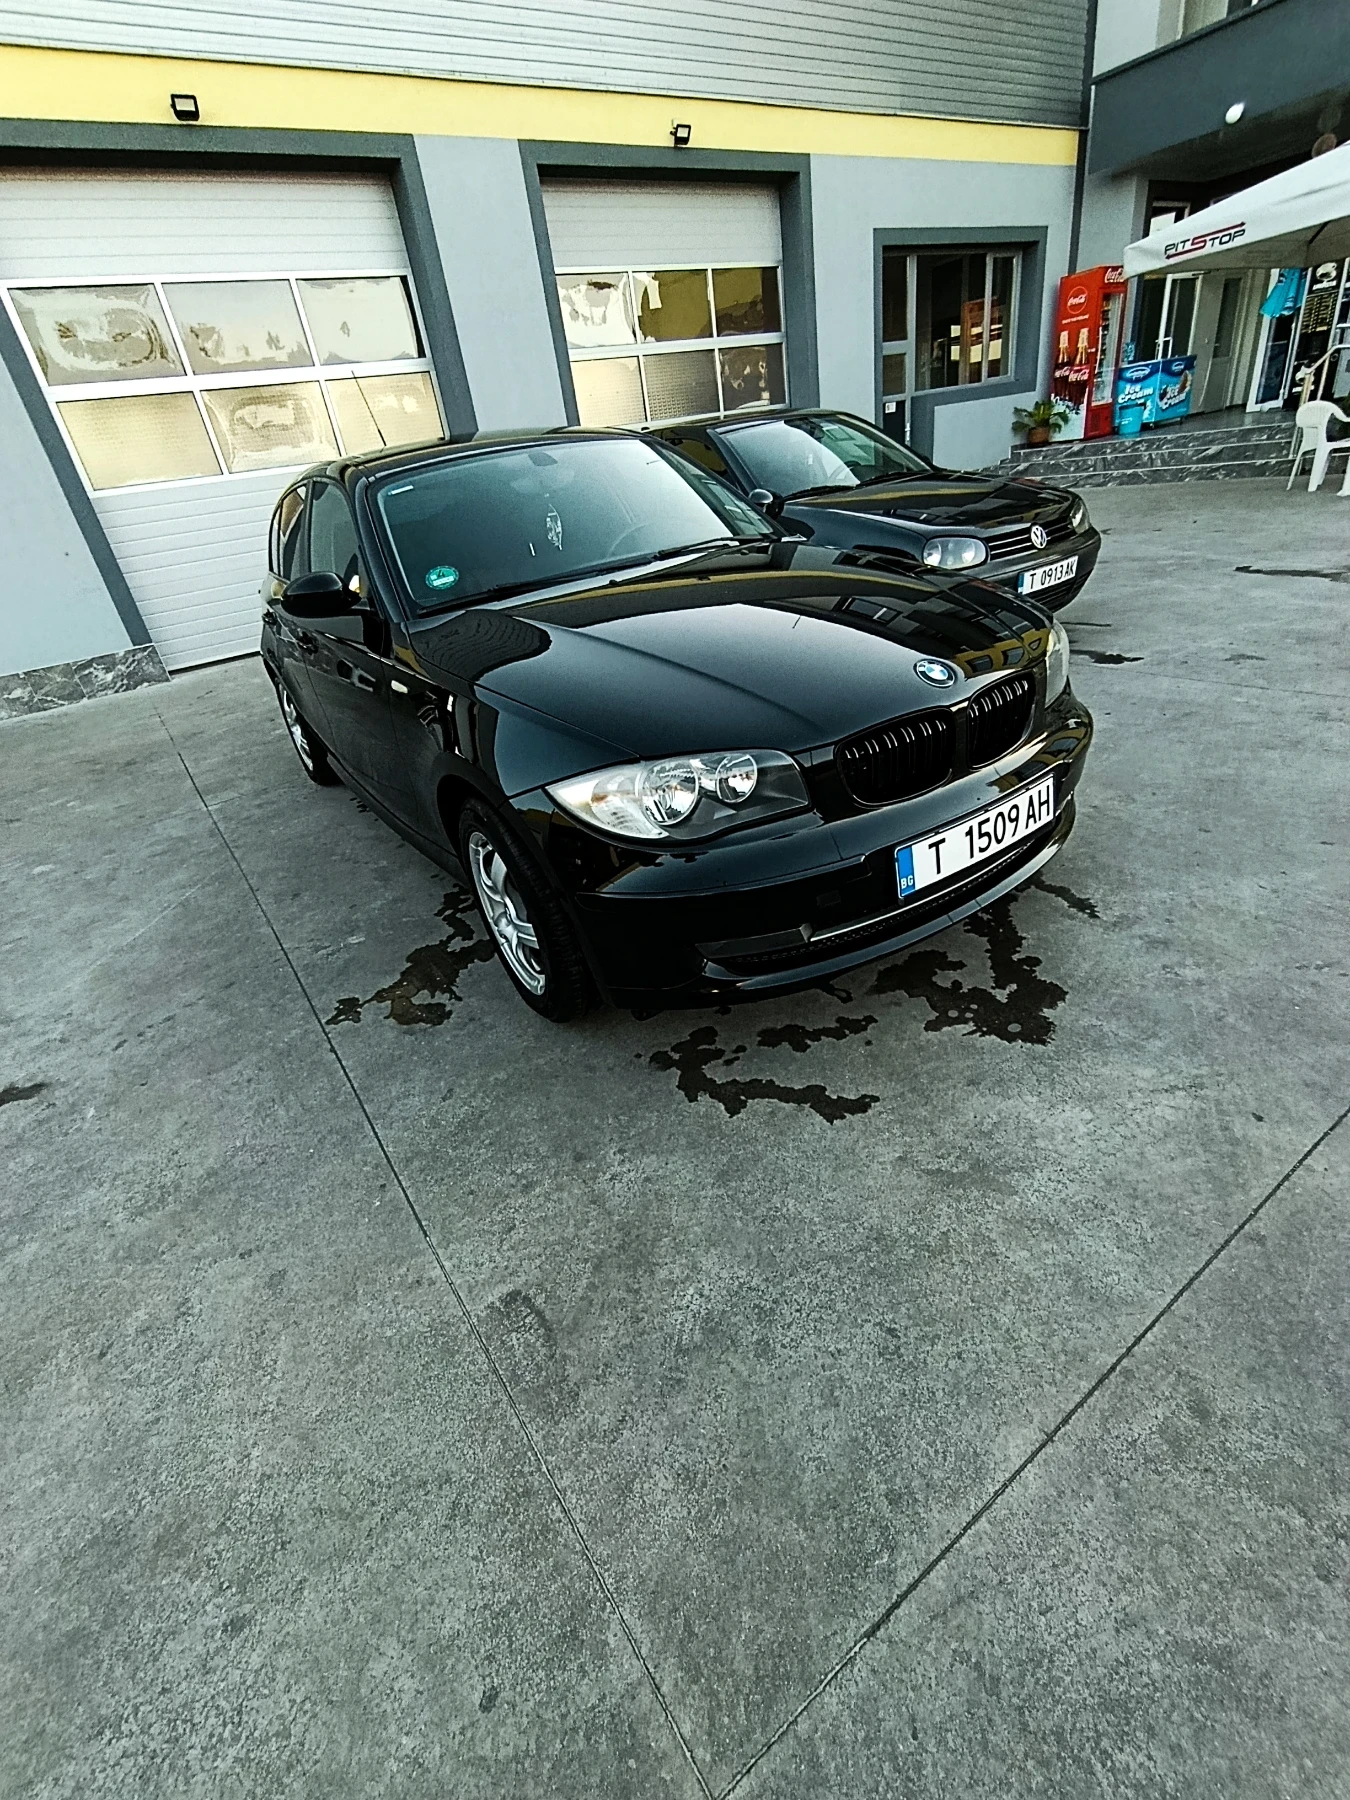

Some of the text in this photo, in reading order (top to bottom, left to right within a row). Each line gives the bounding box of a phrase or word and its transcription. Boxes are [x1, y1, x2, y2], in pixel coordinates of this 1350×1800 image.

[1164, 227, 1246, 256] PITSTOP
[1118, 387, 1154, 403] Cream
[1125, 383, 1142, 395] Ice
[1029, 572, 1037, 590] T
[1040, 564, 1064, 586] 0913
[1064, 559, 1076, 578] AK
[928, 784, 1051, 875] T 1509 AH
[900, 874, 914, 890] BG
